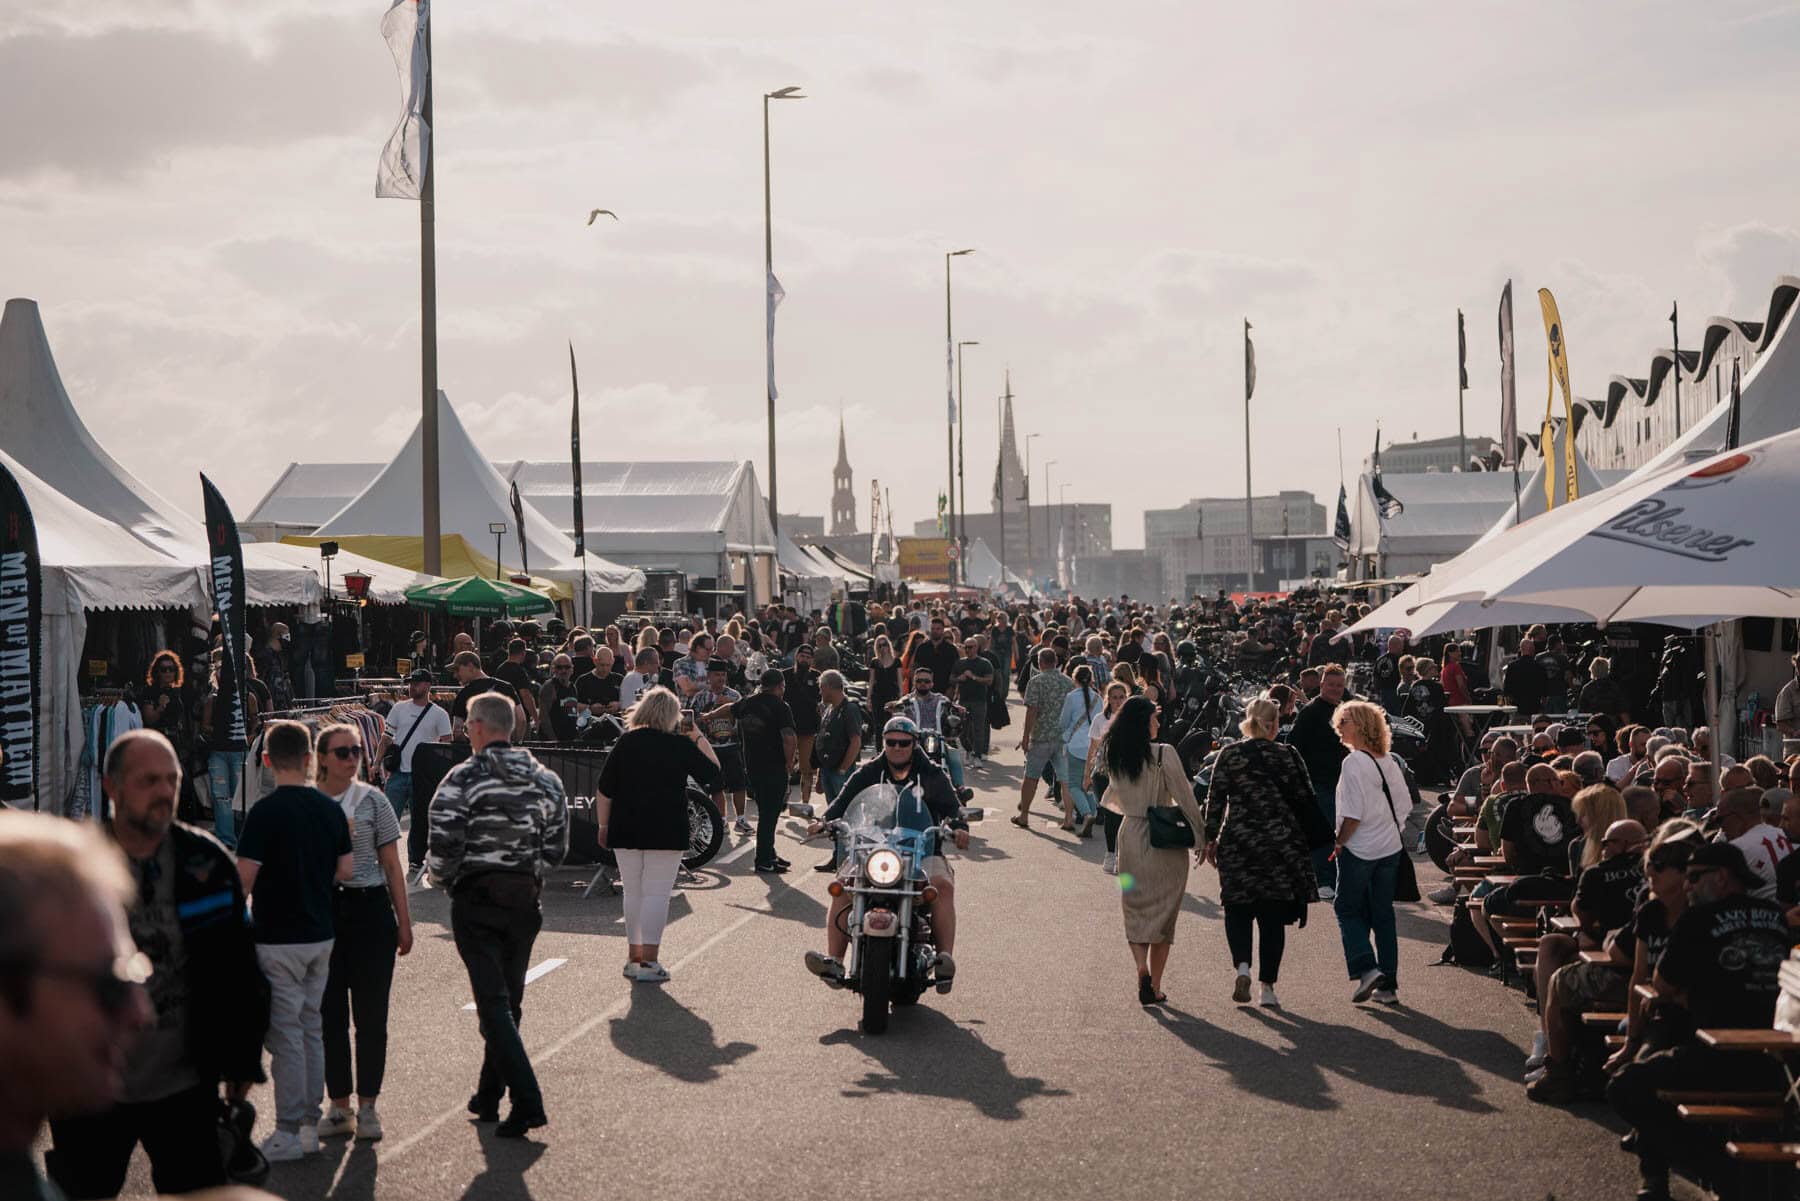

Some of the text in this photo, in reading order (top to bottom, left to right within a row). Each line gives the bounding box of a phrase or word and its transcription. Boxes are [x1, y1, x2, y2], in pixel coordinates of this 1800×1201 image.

[1604, 498, 1755, 555] Pilsener
[213, 554, 233, 611] MEN
[0, 551, 33, 786] MEN OF MAYHEM
[564, 796, 596, 809] LEY
